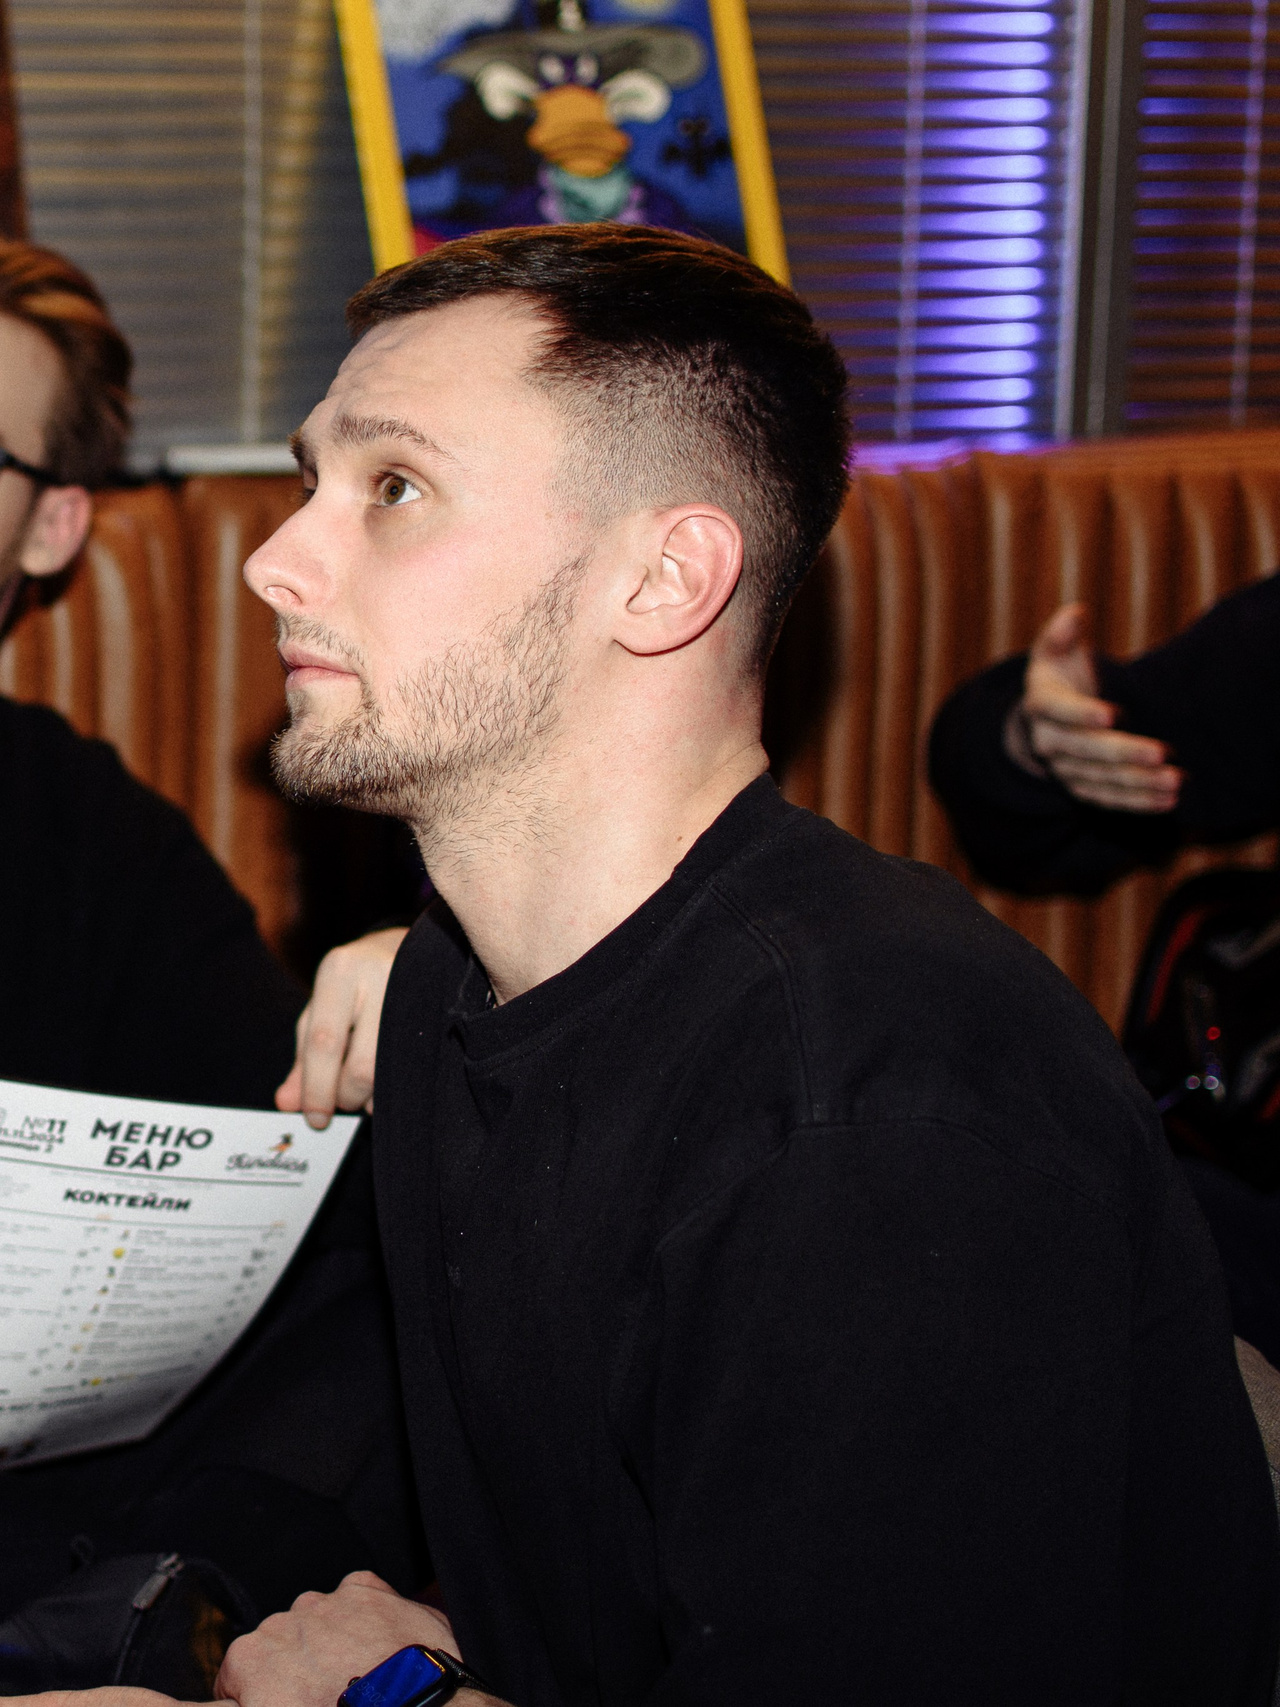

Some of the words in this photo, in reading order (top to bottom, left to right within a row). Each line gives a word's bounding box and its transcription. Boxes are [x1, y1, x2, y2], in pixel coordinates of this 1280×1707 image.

[90, 1117, 214, 1150] МЕНЮ
[104, 1146, 182, 1172] БАР
[63, 1187, 192, 1212] КОКТЕЙЛИ
